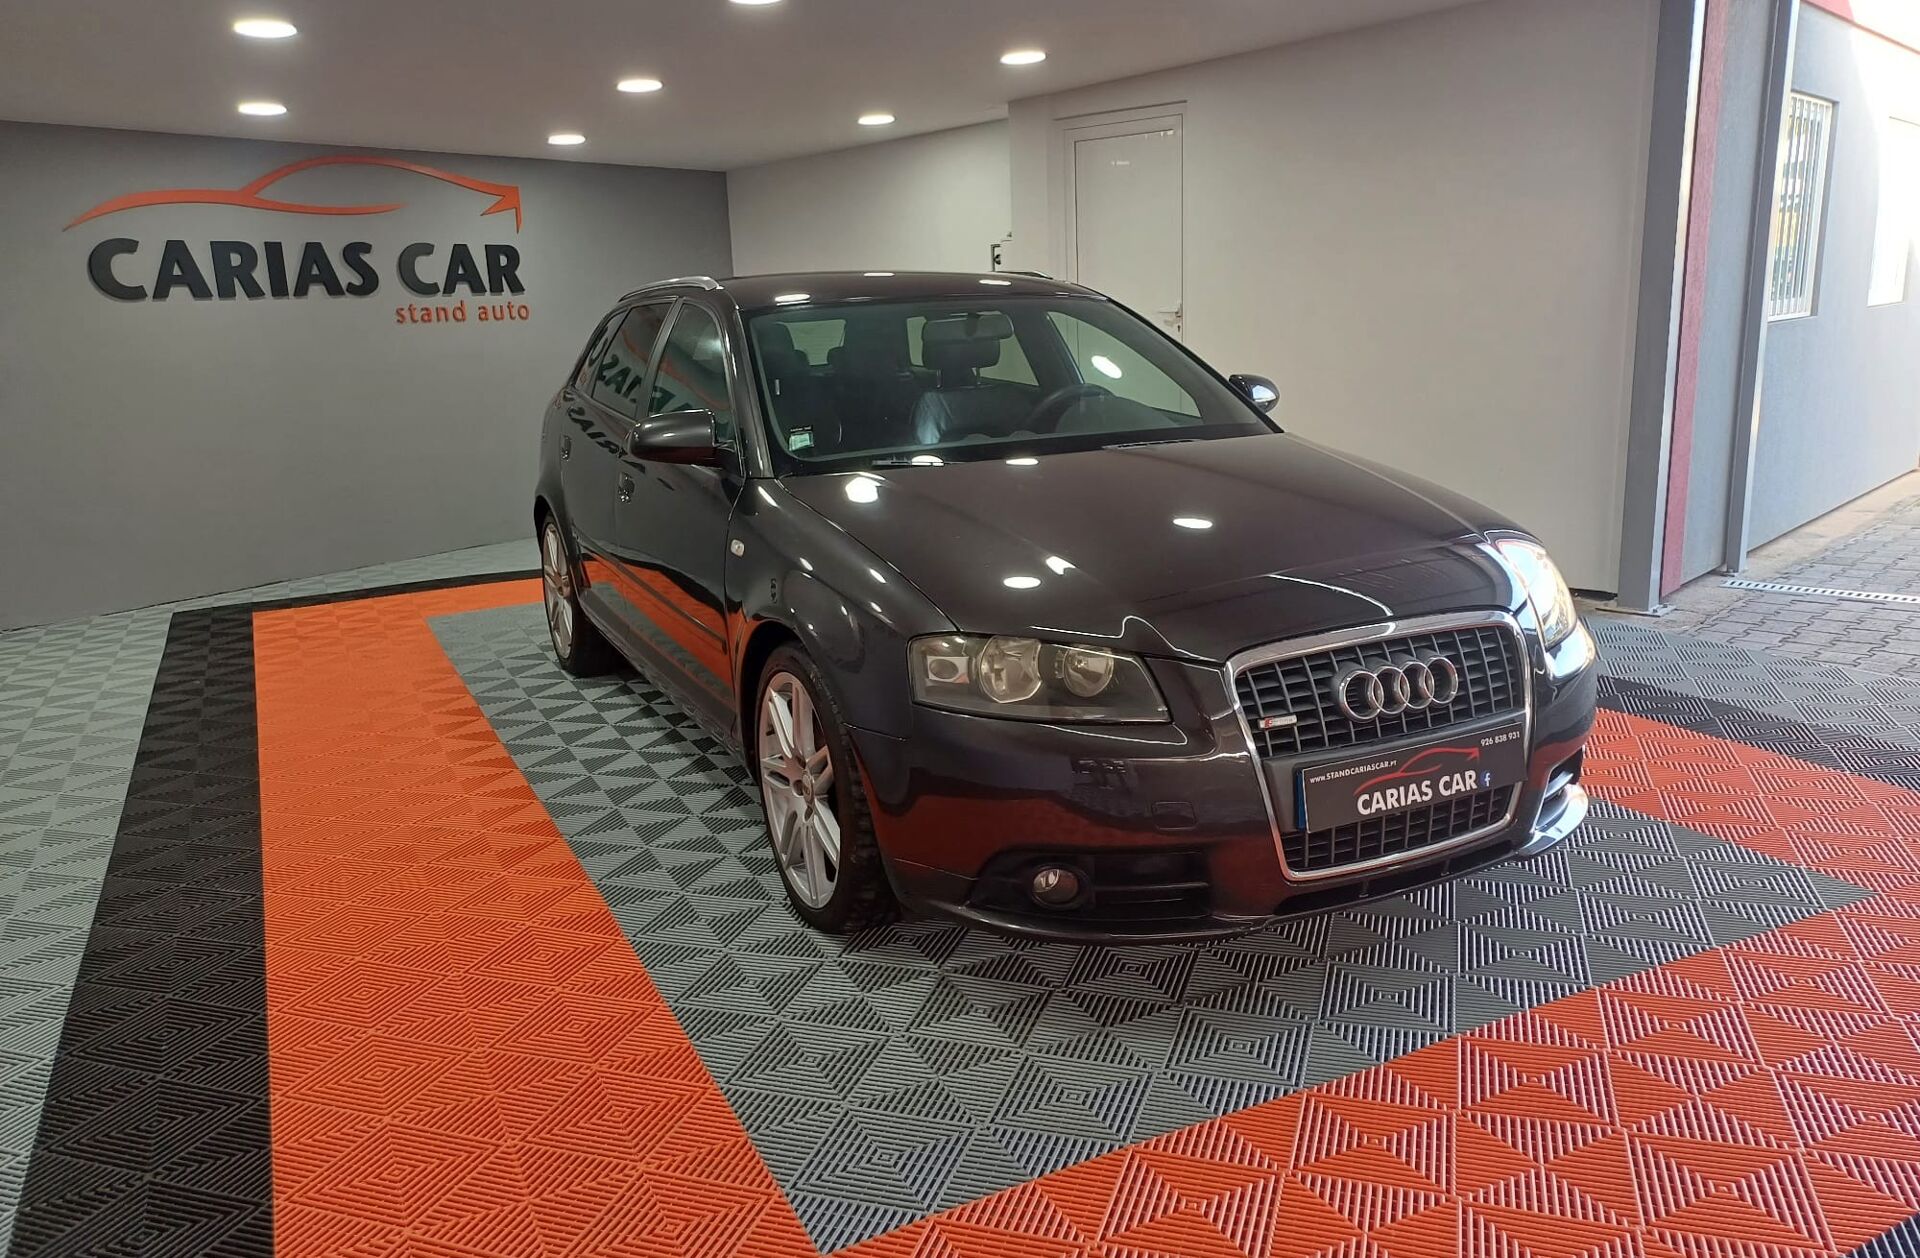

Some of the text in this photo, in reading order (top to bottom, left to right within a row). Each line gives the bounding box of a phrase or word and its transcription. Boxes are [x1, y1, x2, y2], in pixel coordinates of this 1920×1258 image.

[87, 237, 526, 302] CARIAS CAR
[395, 299, 531, 325] stand auto
[1480, 737, 1494, 747] 926
[1508, 730, 1520, 740] 931
[1357, 780, 1433, 815] CARIAS
[1438, 769, 1478, 796] CAR
